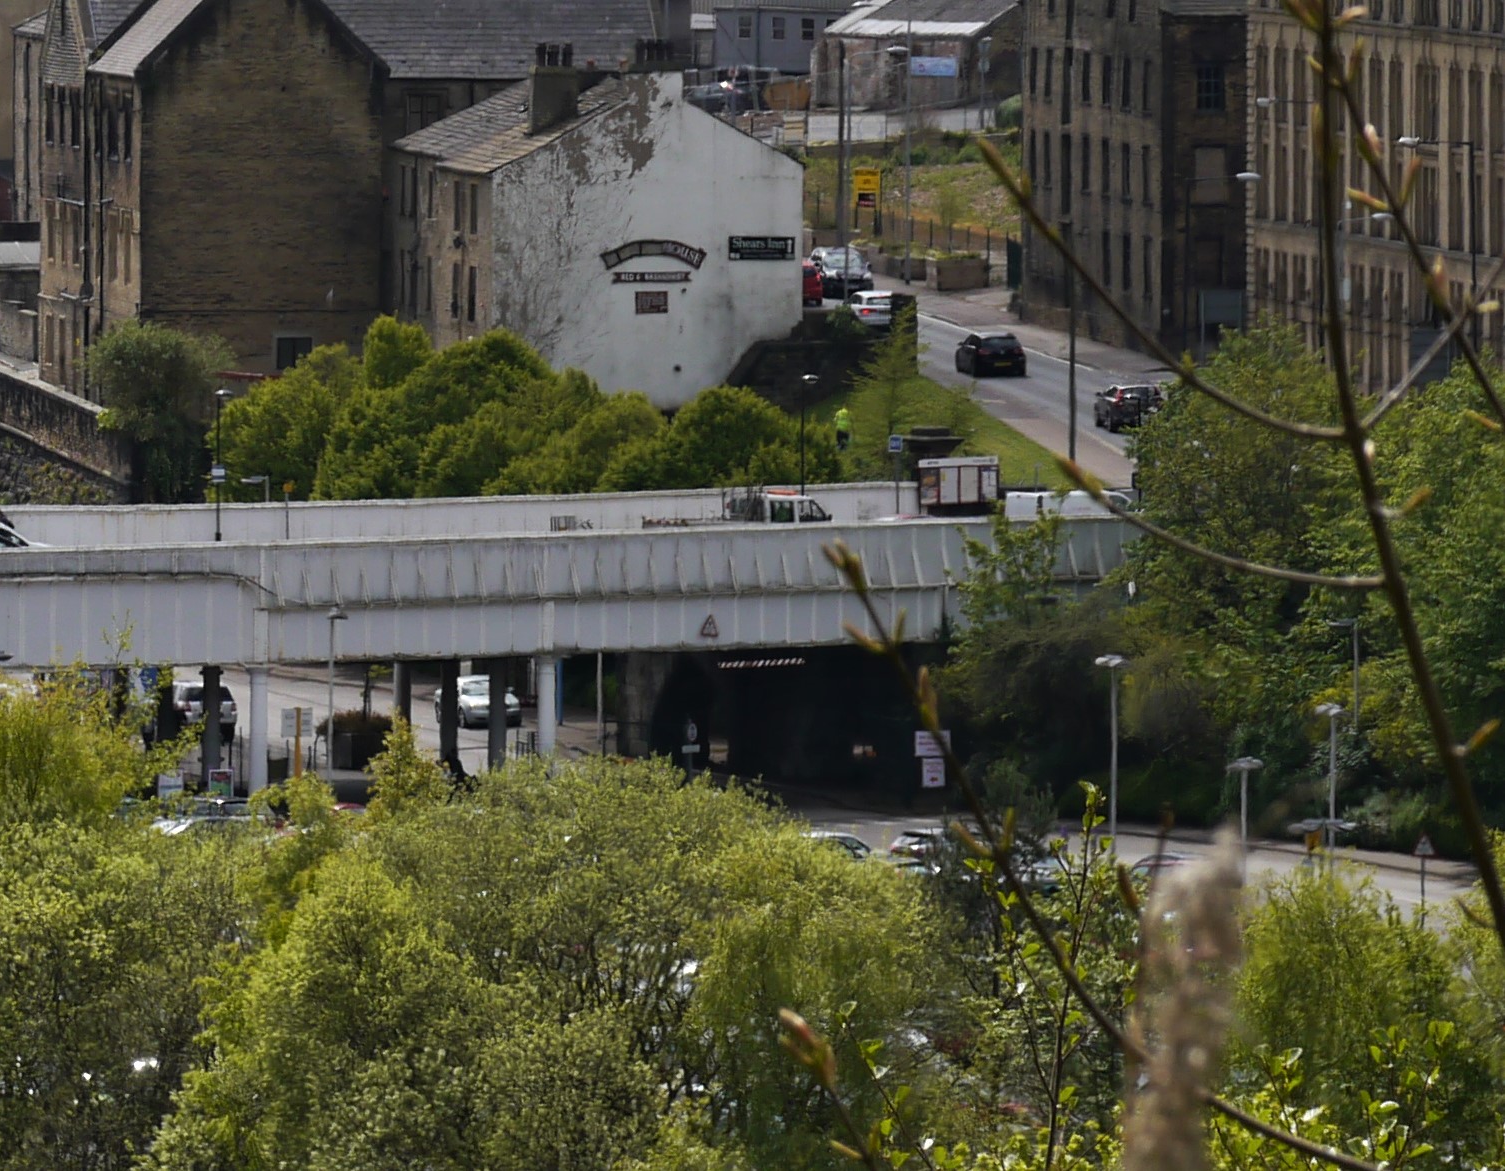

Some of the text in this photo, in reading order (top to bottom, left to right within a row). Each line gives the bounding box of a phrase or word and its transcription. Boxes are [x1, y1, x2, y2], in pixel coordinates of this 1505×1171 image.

[732, 237, 786, 249] Shears Inn
[663, 241, 702, 266] HOUSE
